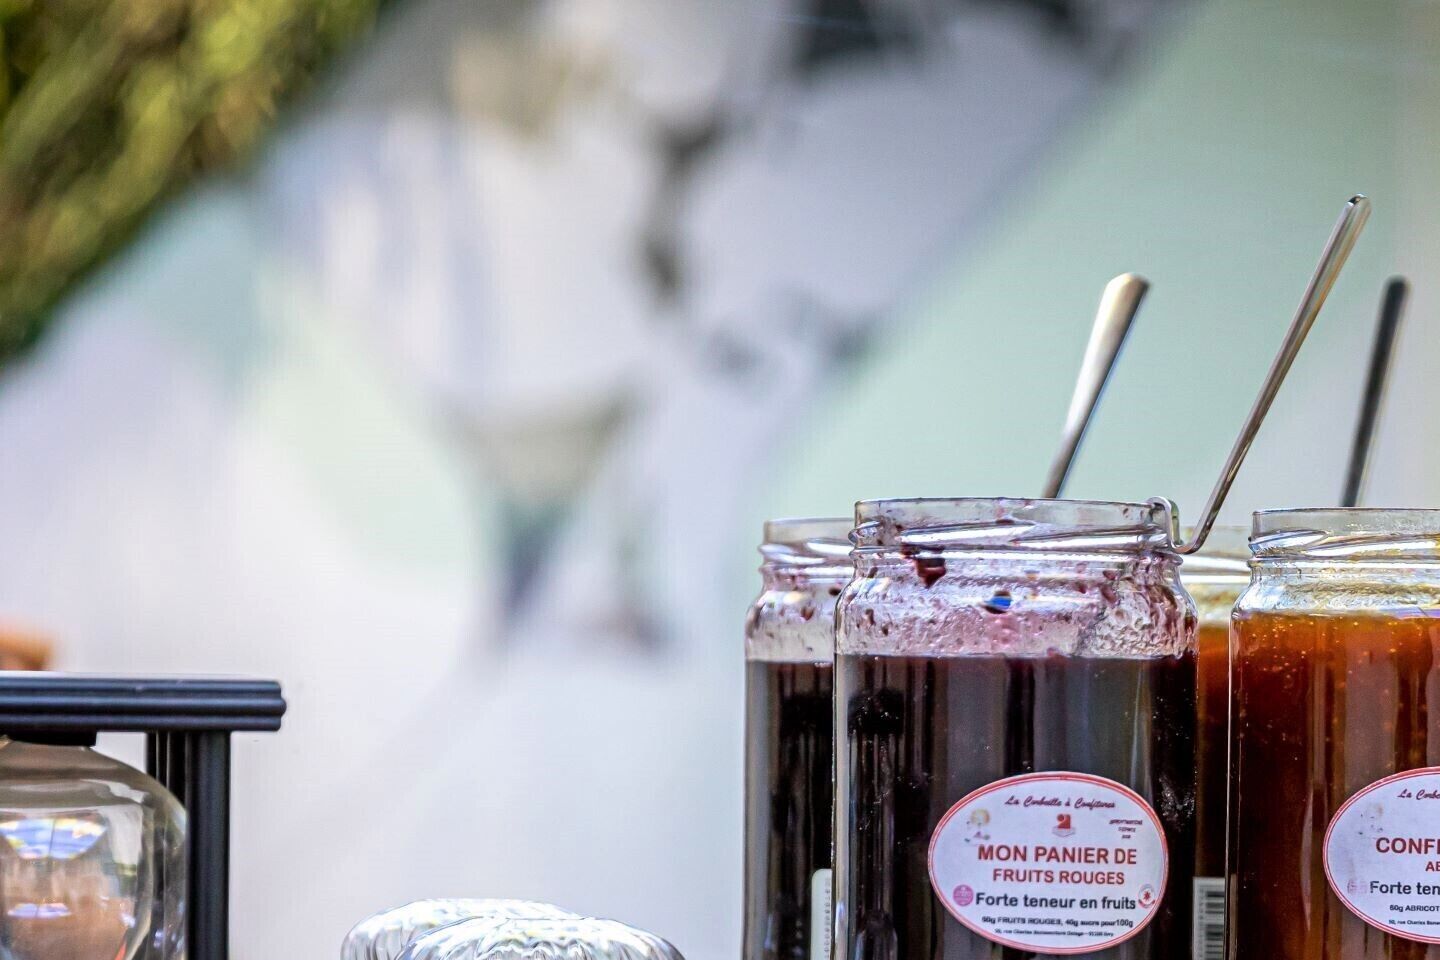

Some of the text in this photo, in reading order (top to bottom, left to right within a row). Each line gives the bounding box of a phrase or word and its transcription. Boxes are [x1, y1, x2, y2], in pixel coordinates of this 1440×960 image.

[1005, 795, 1019, 805] La
[1397, 788, 1412, 799] La
[978, 845, 1137, 865] MON PANIER DE
[993, 868, 1125, 885] FRUITS ROUGES
[1370, 880, 1411, 895] Forte
[976, 893, 1019, 907] Forte
[1024, 894, 1076, 909] teneur
[1080, 898, 1098, 909] en
[1101, 896, 1136, 910] fruits
[998, 916, 1026, 925] FRUITS
